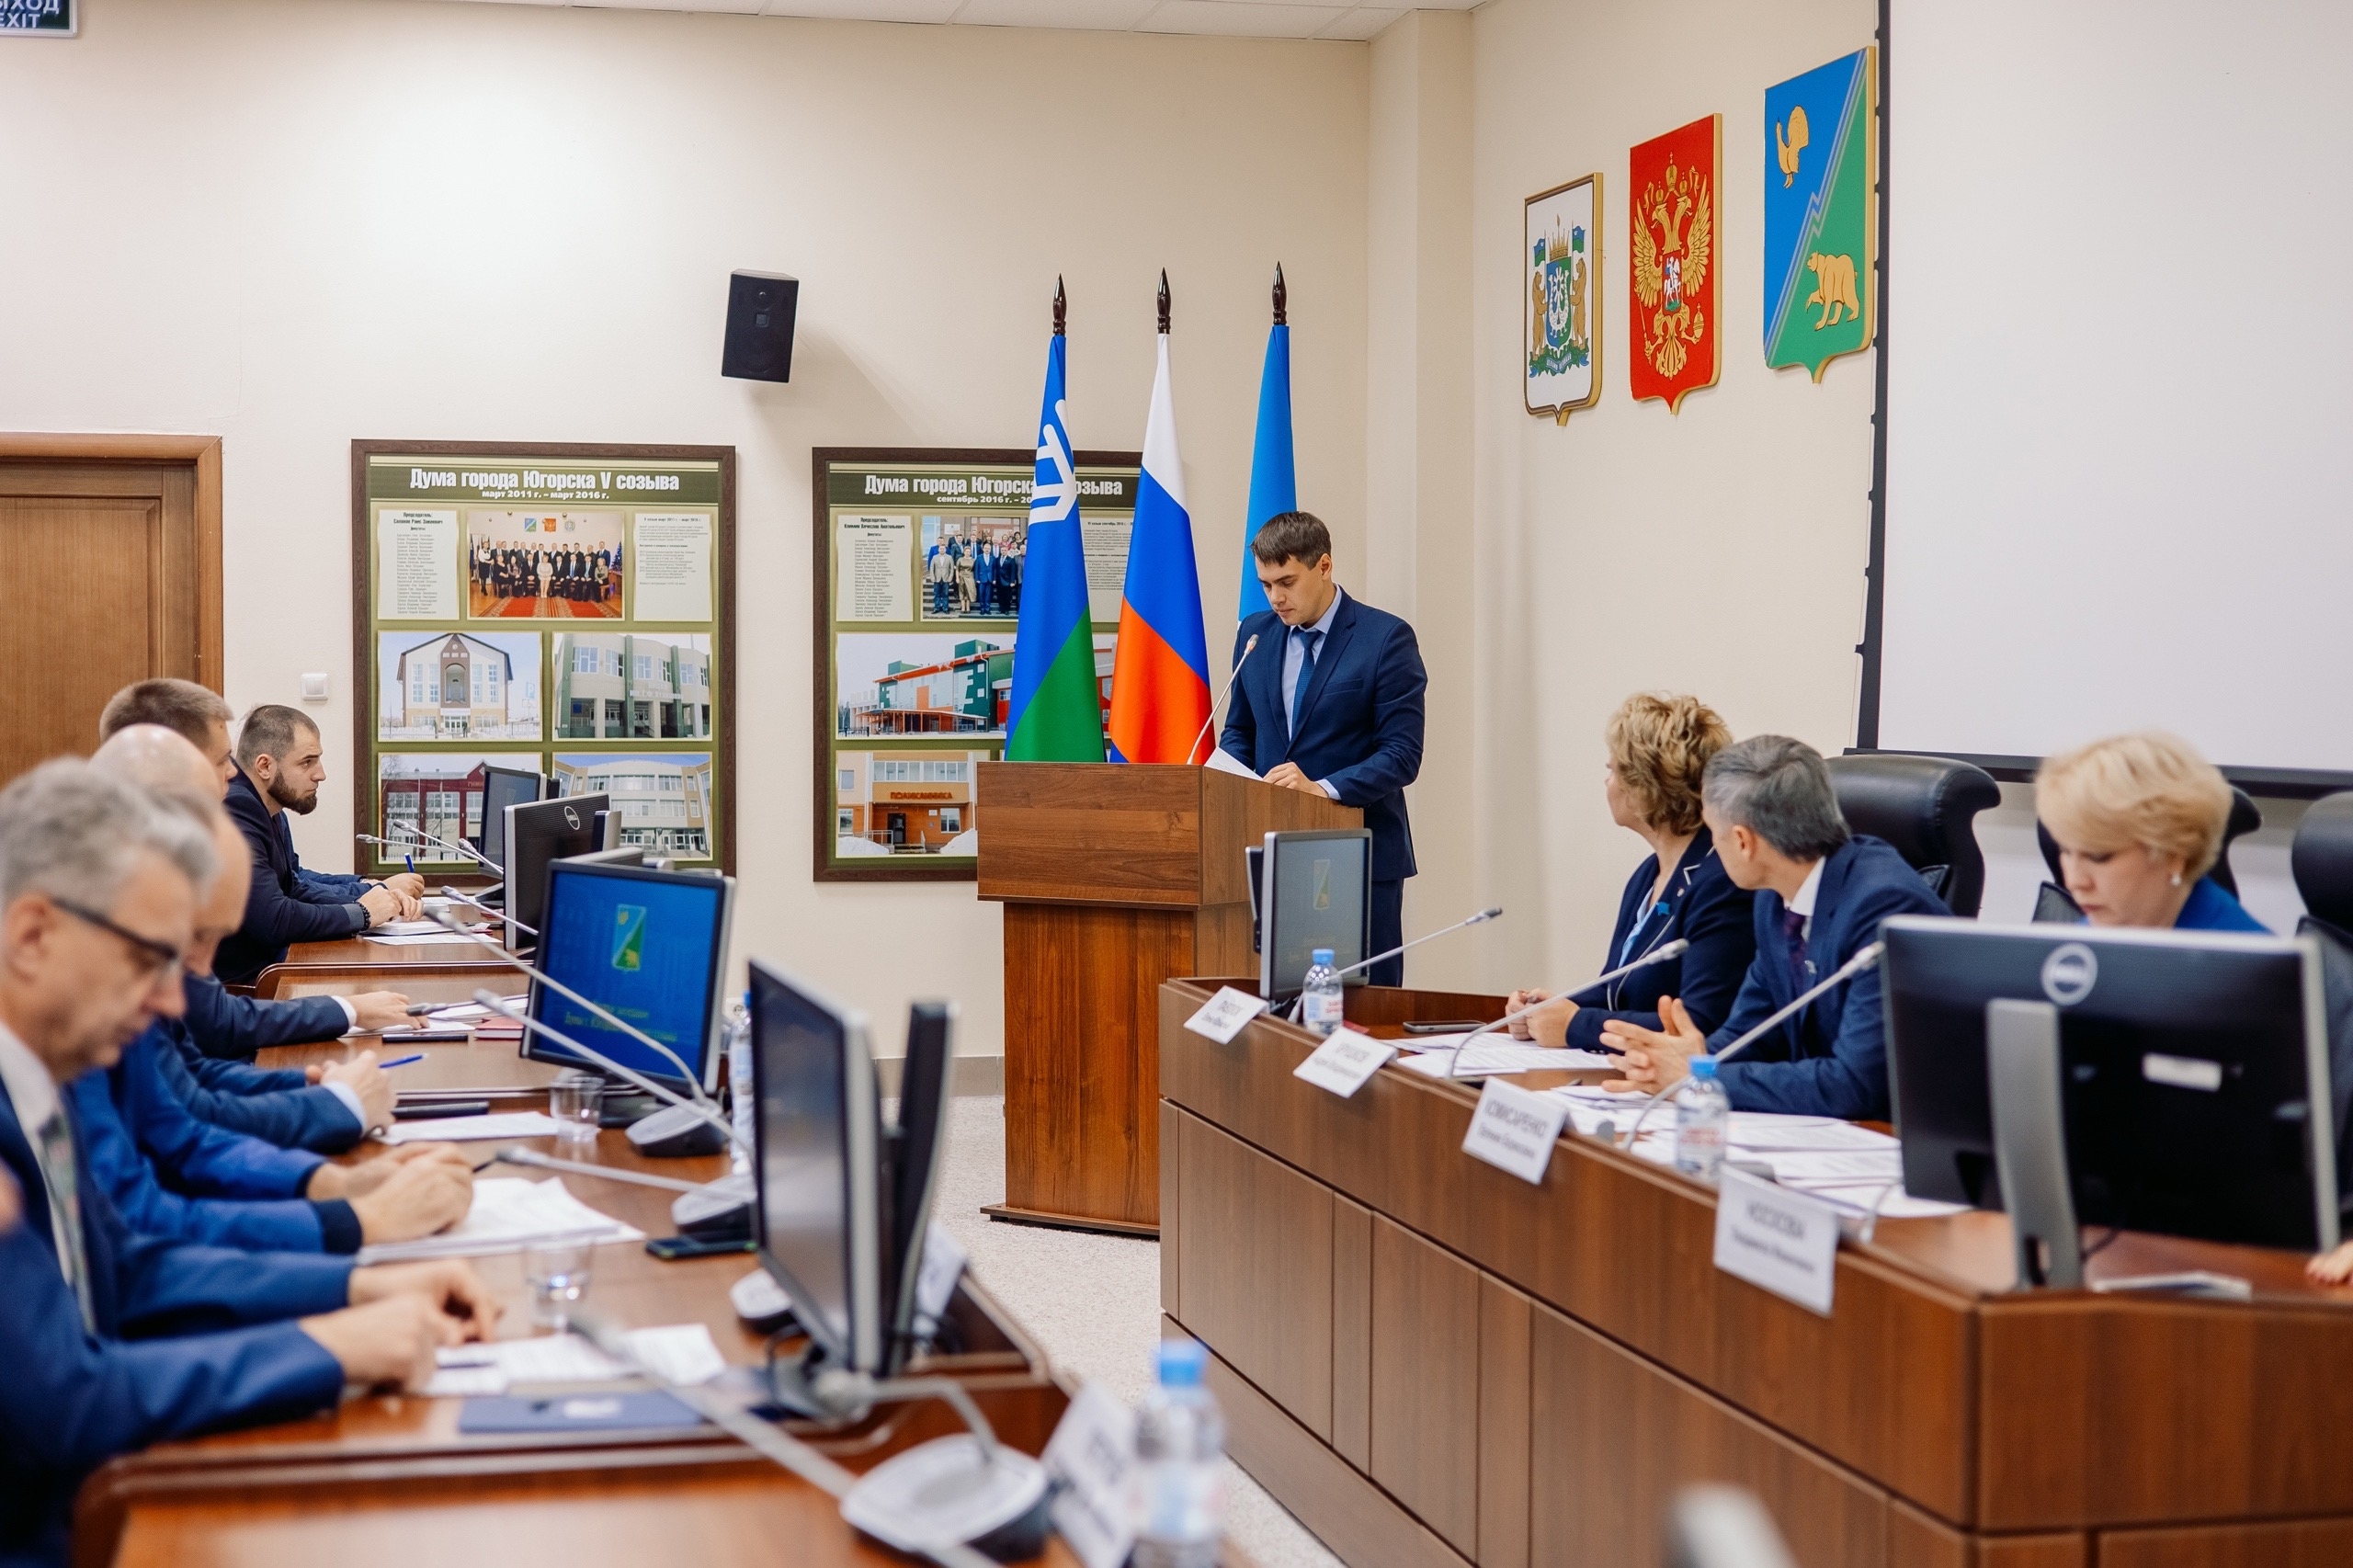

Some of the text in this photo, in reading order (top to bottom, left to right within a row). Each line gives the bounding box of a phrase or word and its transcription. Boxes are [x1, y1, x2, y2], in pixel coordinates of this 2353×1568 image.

[410, 469, 679, 491] Дума города Югорска V созыва
[865, 475, 909, 494] Дума
[913, 479, 968, 495] города
[1075, 481, 1123, 494] озыва
[483, 490, 506, 499] март
[507, 490, 531, 498] 2011
[551, 492, 574, 500] март
[937, 495, 978, 504] сентябрь
[980, 495, 1004, 504] 2016
